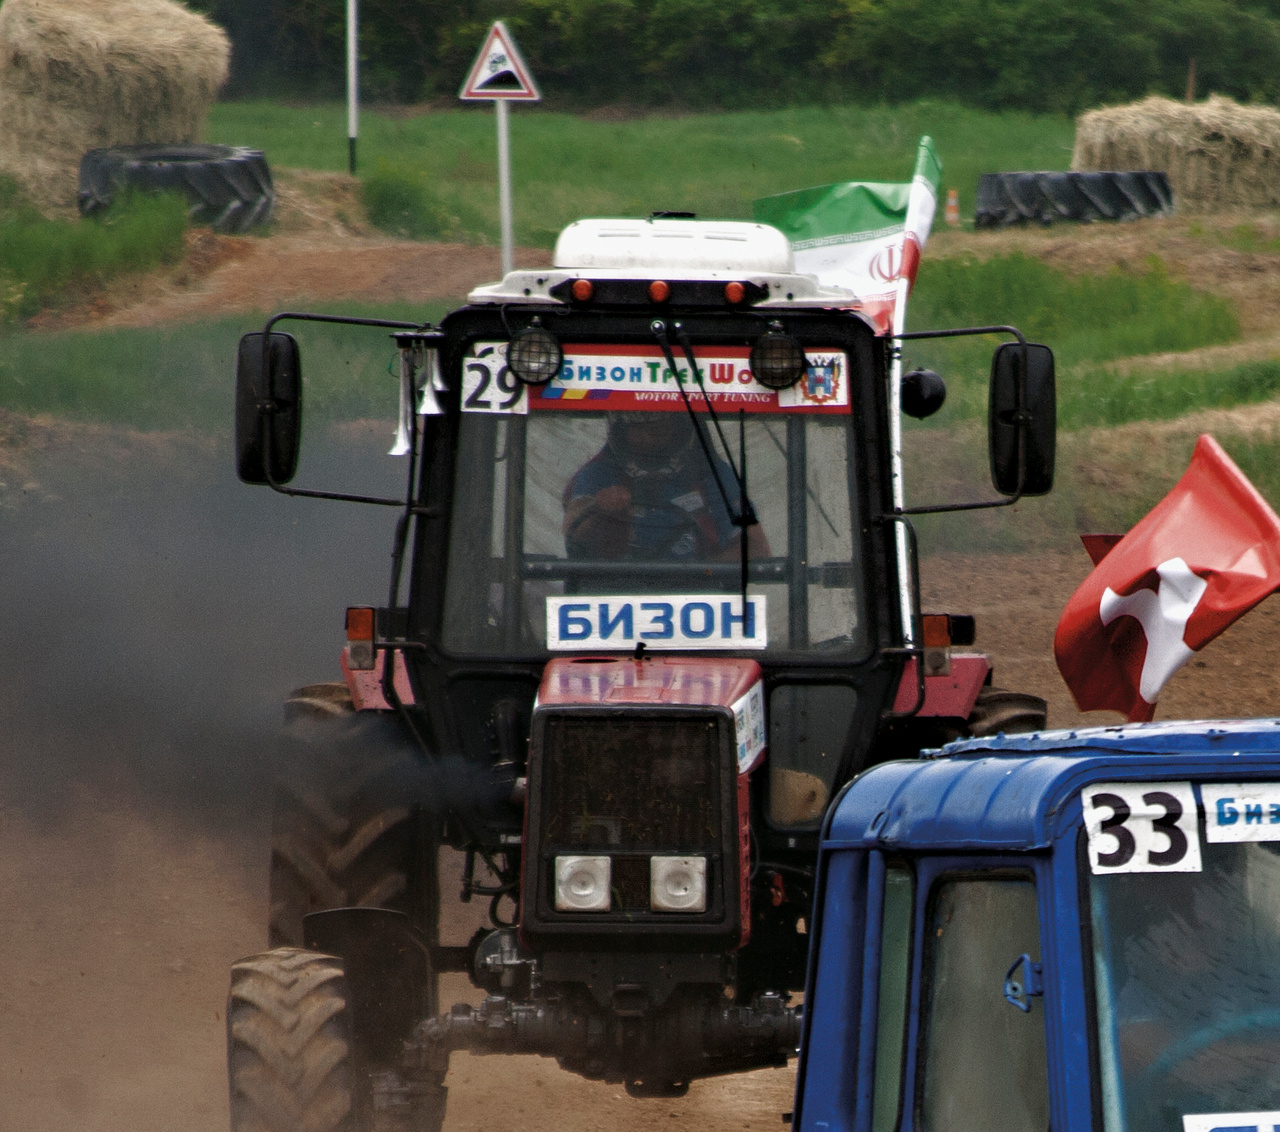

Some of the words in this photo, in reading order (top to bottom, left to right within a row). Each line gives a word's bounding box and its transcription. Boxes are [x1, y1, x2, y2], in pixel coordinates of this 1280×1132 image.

[464, 362, 524, 410] 29
[633, 392, 679, 403] MOTOR
[680, 392, 721, 403] PORT
[723, 392, 770, 403] TUNING
[557, 601, 756, 640] БИЗОН
[1089, 791, 1189, 867] 33
